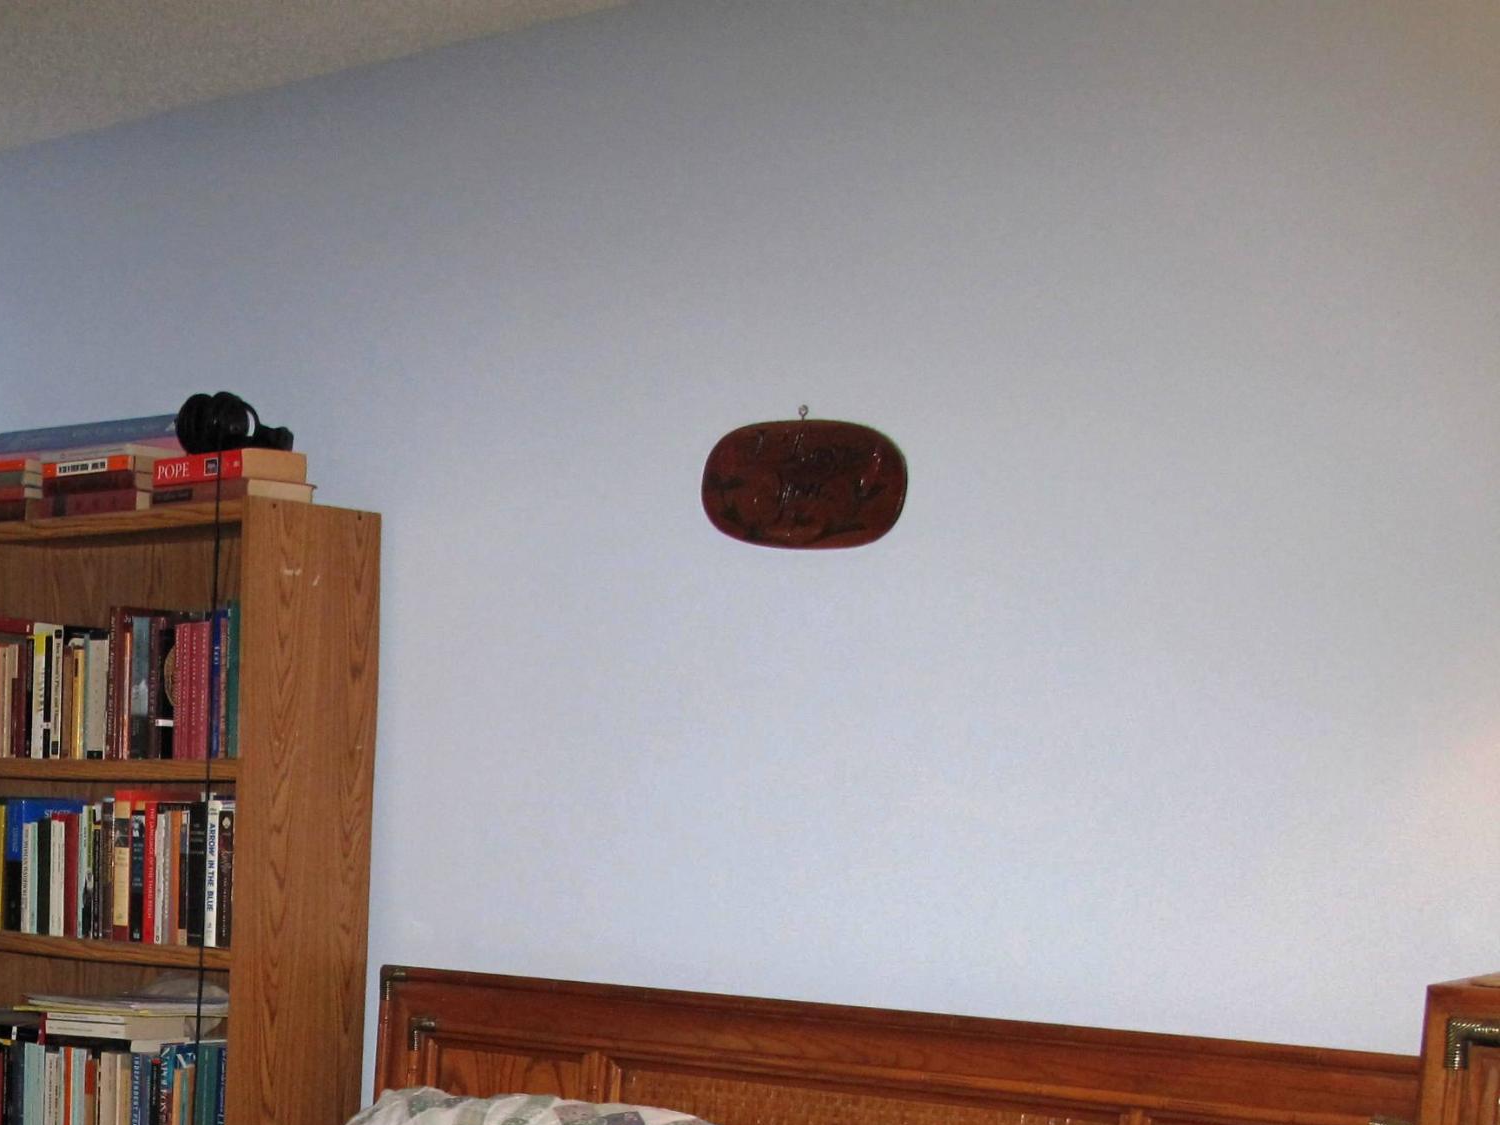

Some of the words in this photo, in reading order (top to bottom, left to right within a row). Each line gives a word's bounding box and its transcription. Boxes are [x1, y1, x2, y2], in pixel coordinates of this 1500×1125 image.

[158, 463, 190, 480] POPE
[207, 823, 215, 856] ARROW
[207, 860, 215, 869] IN
[207, 871, 215, 887] THE
[207, 891, 215, 912] BLUE
